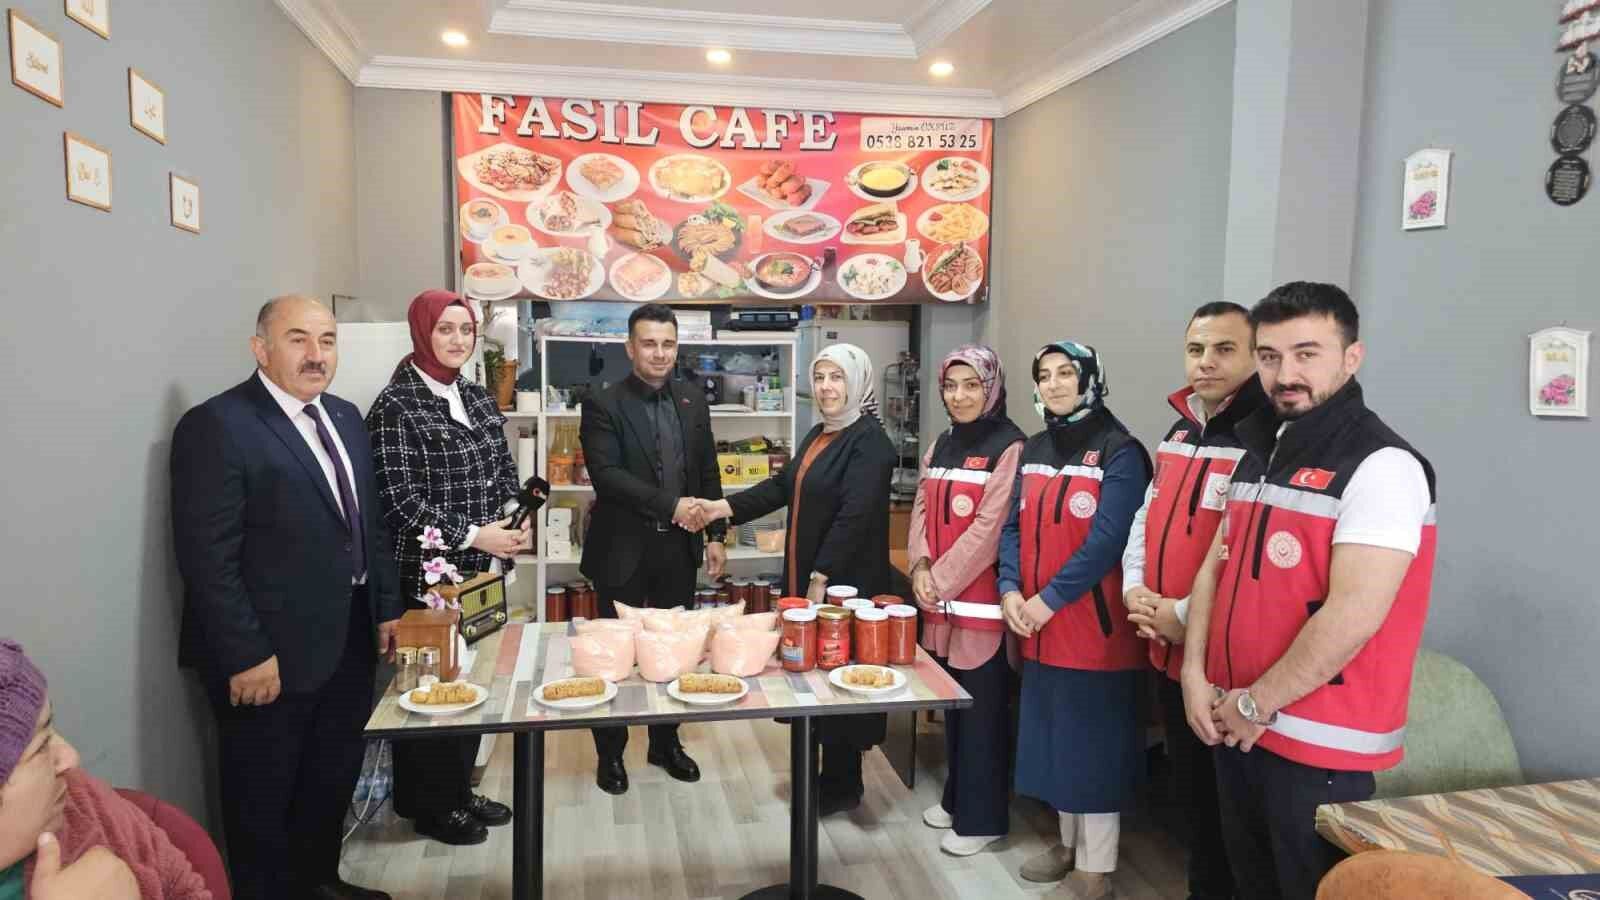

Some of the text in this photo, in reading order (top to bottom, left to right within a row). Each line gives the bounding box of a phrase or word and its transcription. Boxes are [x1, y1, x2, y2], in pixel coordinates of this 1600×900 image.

[479, 93, 837, 151] FASIL CAFE
[907, 135, 933, 148] 821
[939, 134, 955, 148] 53
[959, 134, 977, 148] 25
